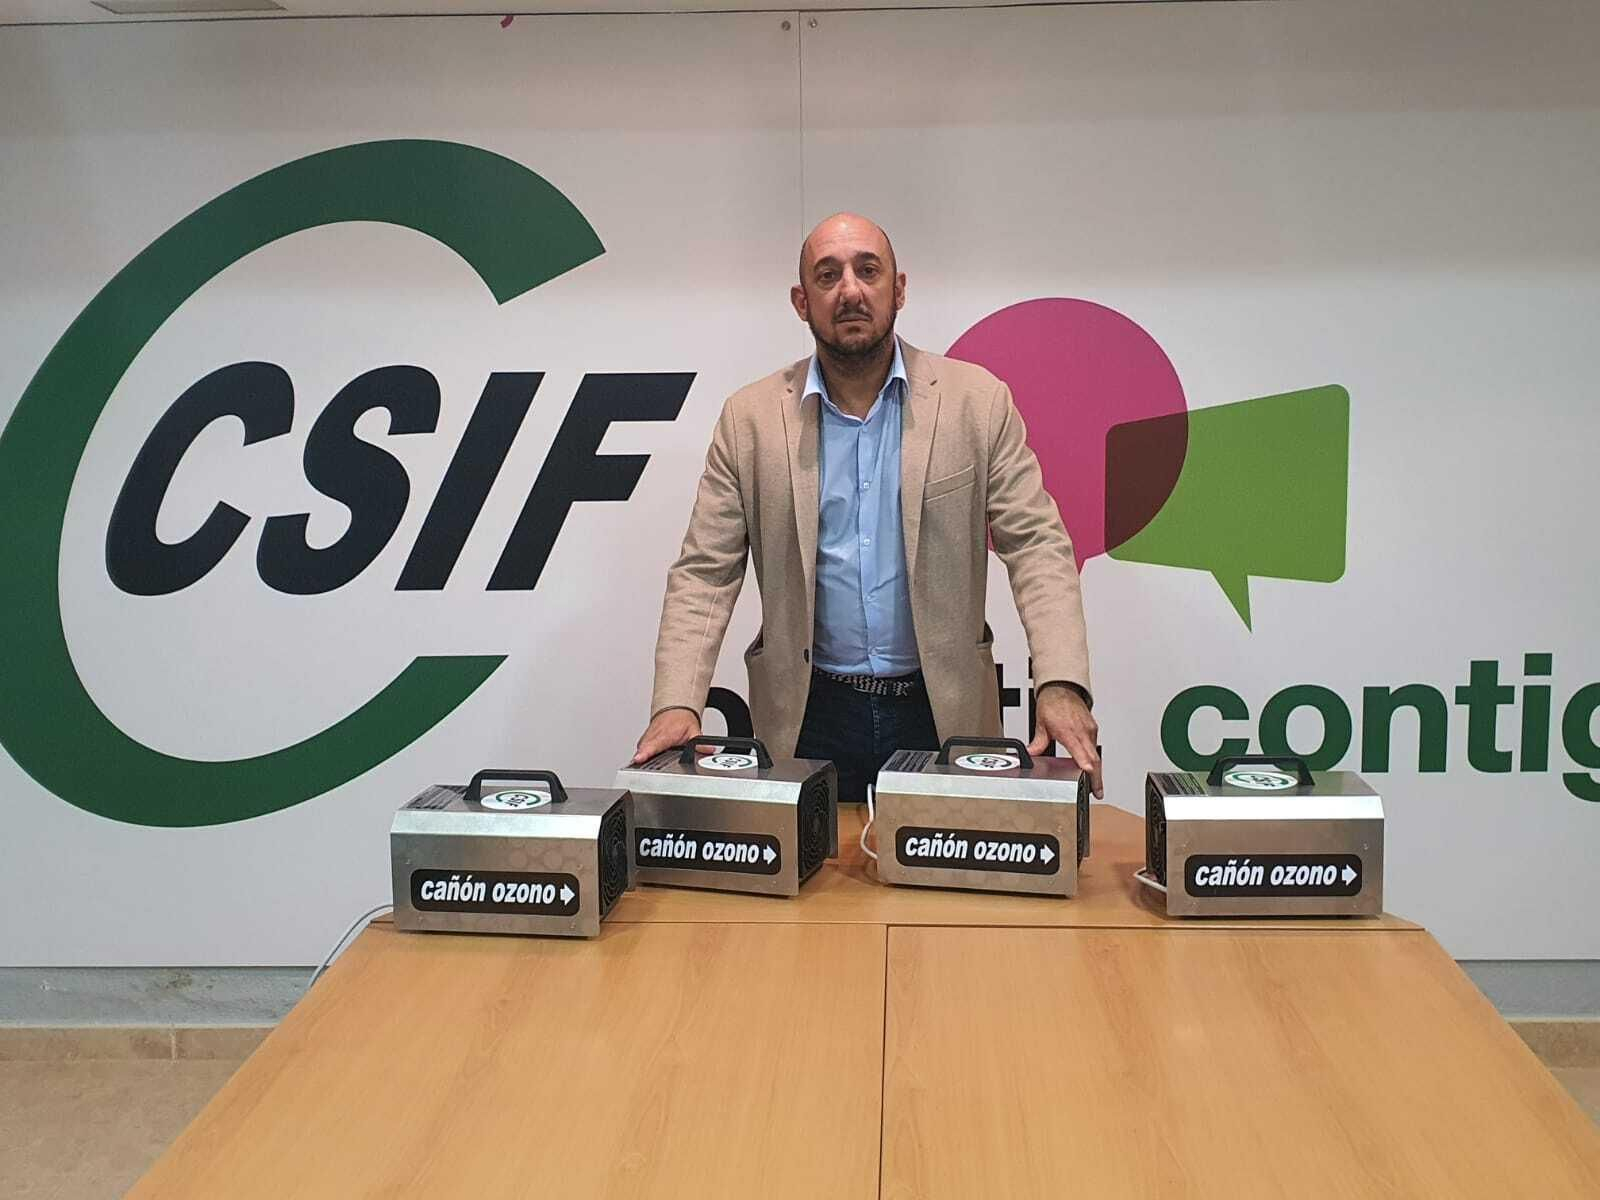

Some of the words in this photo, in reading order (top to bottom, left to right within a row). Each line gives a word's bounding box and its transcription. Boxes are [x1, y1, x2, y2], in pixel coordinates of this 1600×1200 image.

[106, 361, 697, 596] CSIF
[639, 833, 697, 859] cañón
[702, 841, 760, 864] ozono
[905, 832, 969, 859] cañón
[973, 840, 1036, 863] ozono
[1195, 858, 1264, 886] cañón
[1270, 865, 1338, 886] ozono
[420, 874, 487, 902] cañón
[492, 882, 556, 905] ozono
